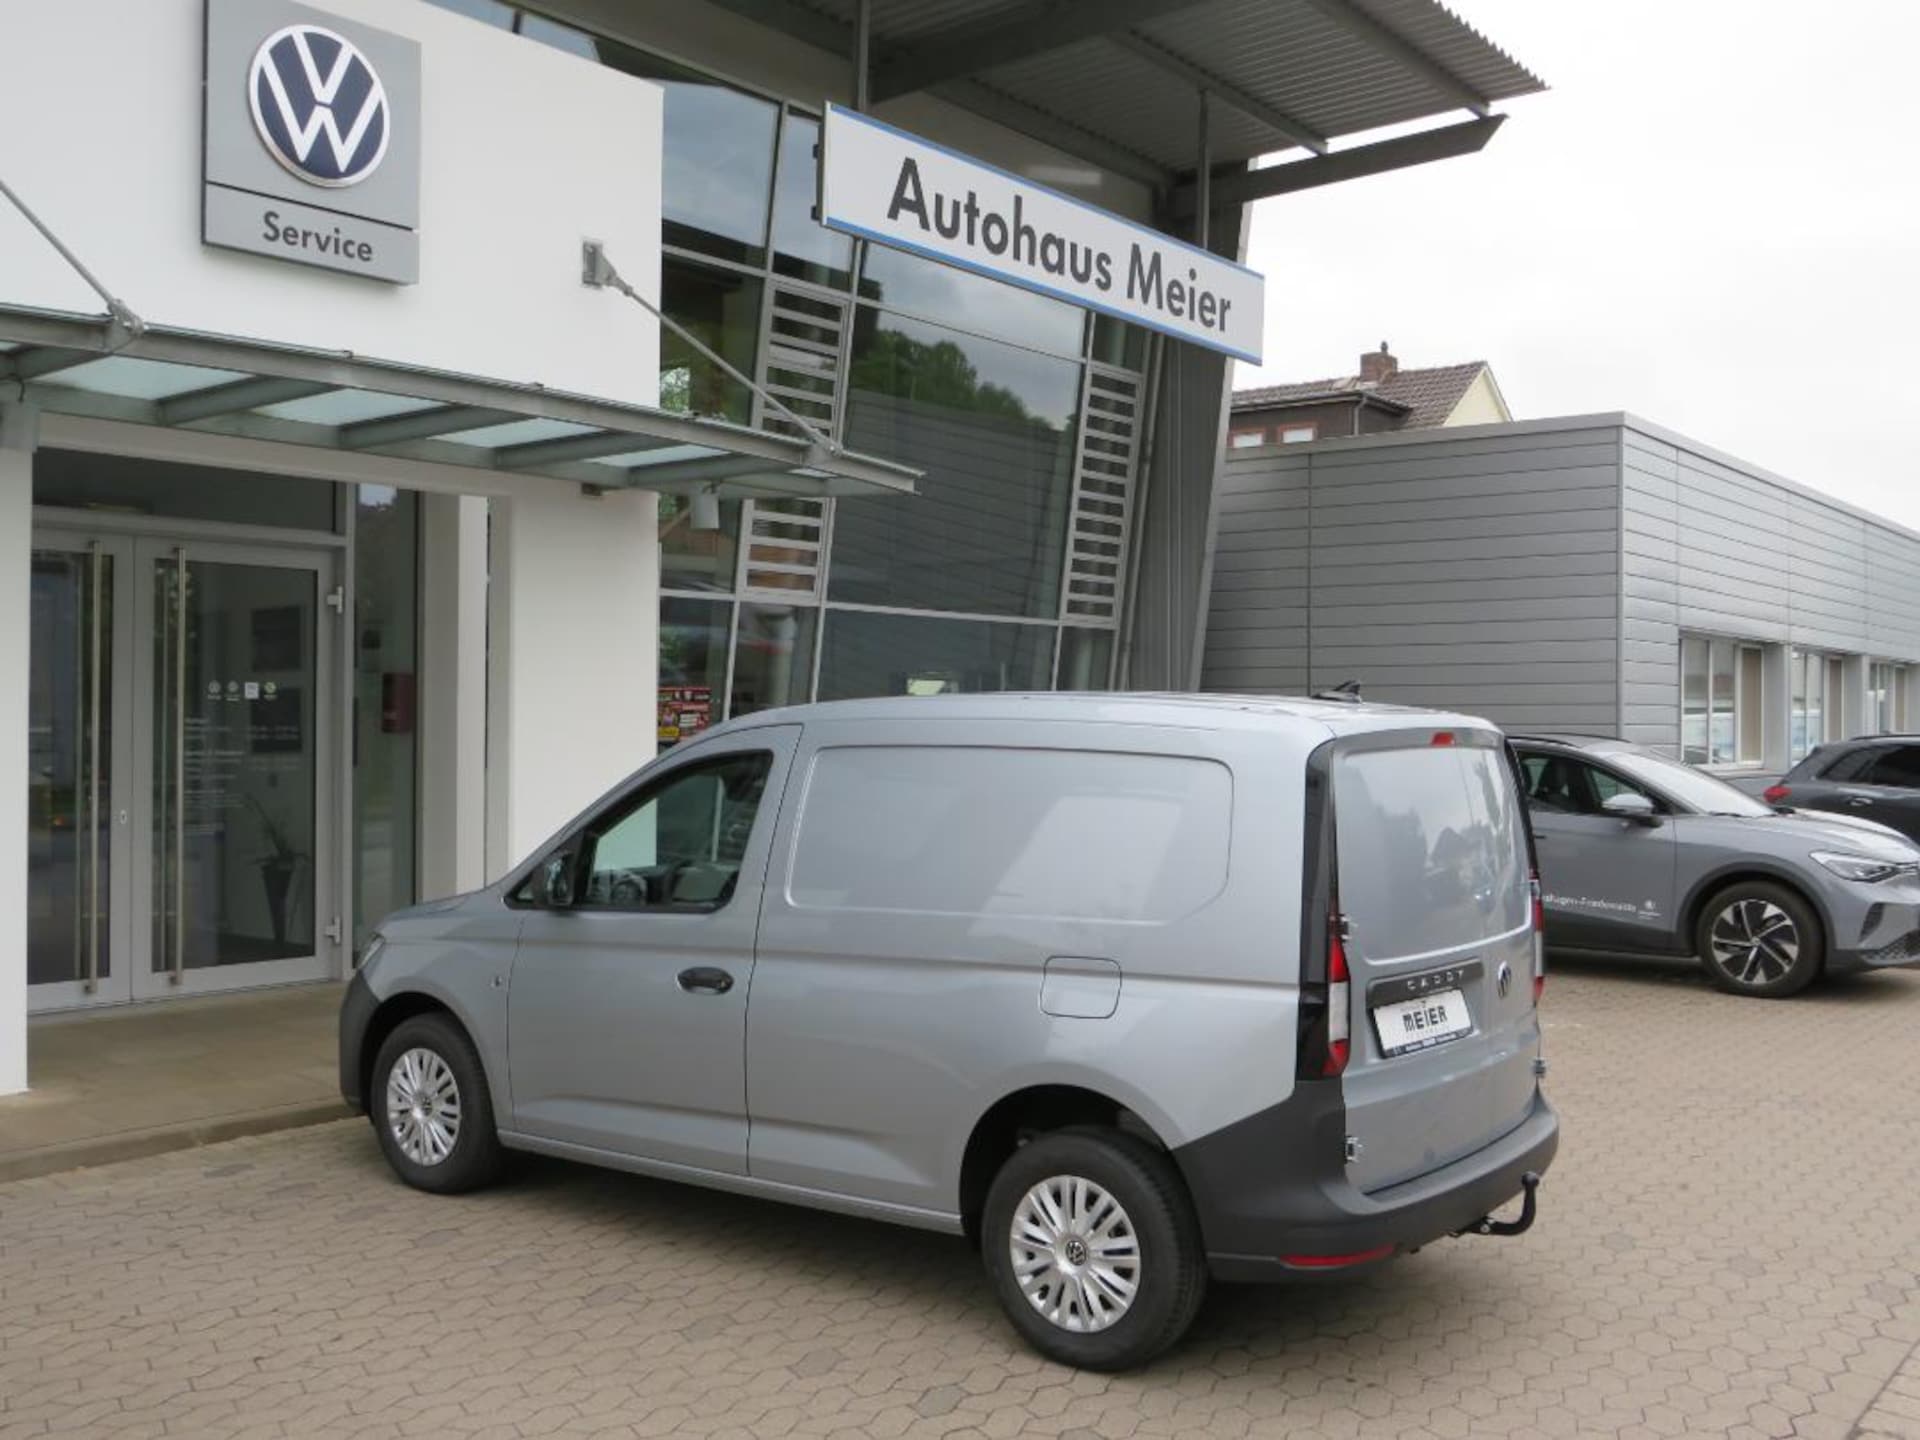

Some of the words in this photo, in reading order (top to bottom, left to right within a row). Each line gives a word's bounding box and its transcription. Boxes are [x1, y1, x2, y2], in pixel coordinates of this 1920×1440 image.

[253, 27, 386, 177] VW
[262, 210, 374, 262] Service
[887, 156, 1112, 291] Autohaus
[1127, 242, 1232, 333] Meier
[1402, 1005, 1448, 1032] MEIER
